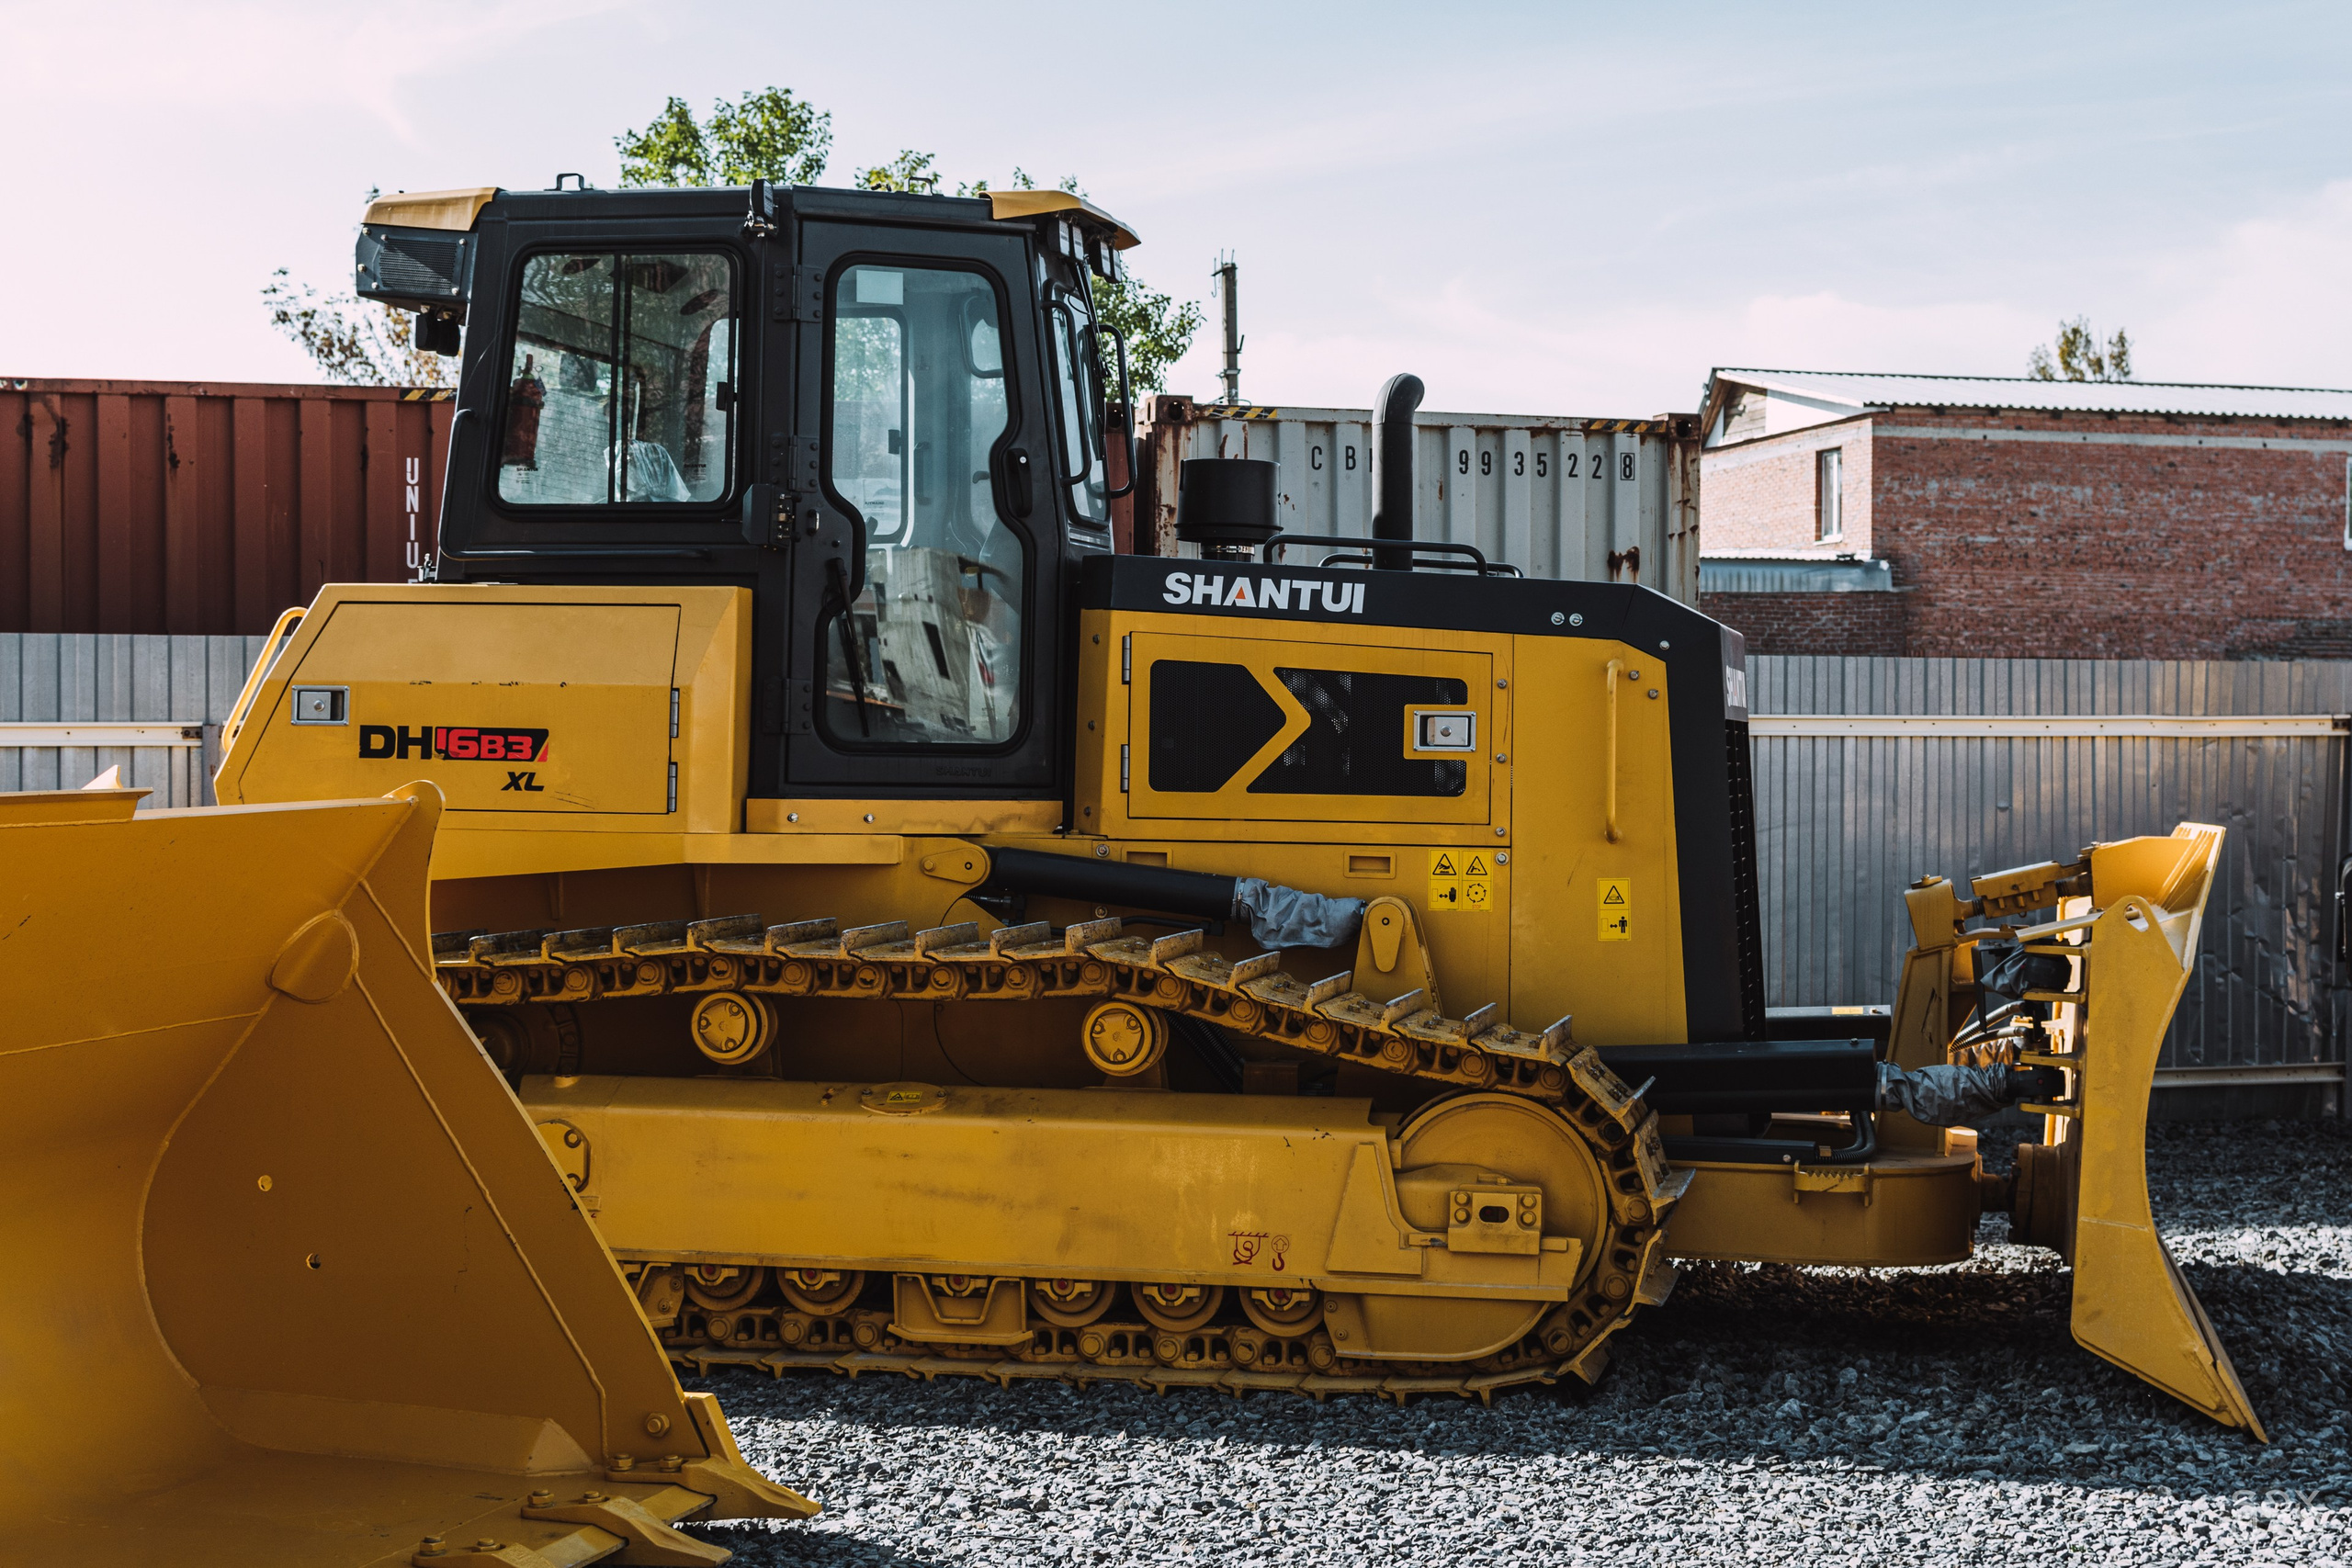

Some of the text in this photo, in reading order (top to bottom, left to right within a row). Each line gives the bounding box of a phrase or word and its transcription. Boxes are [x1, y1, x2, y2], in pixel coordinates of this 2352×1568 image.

[1311, 446, 1373, 472] CB
[1162, 571, 1365, 614] SHANTUI
[501, 772, 545, 792] XL
